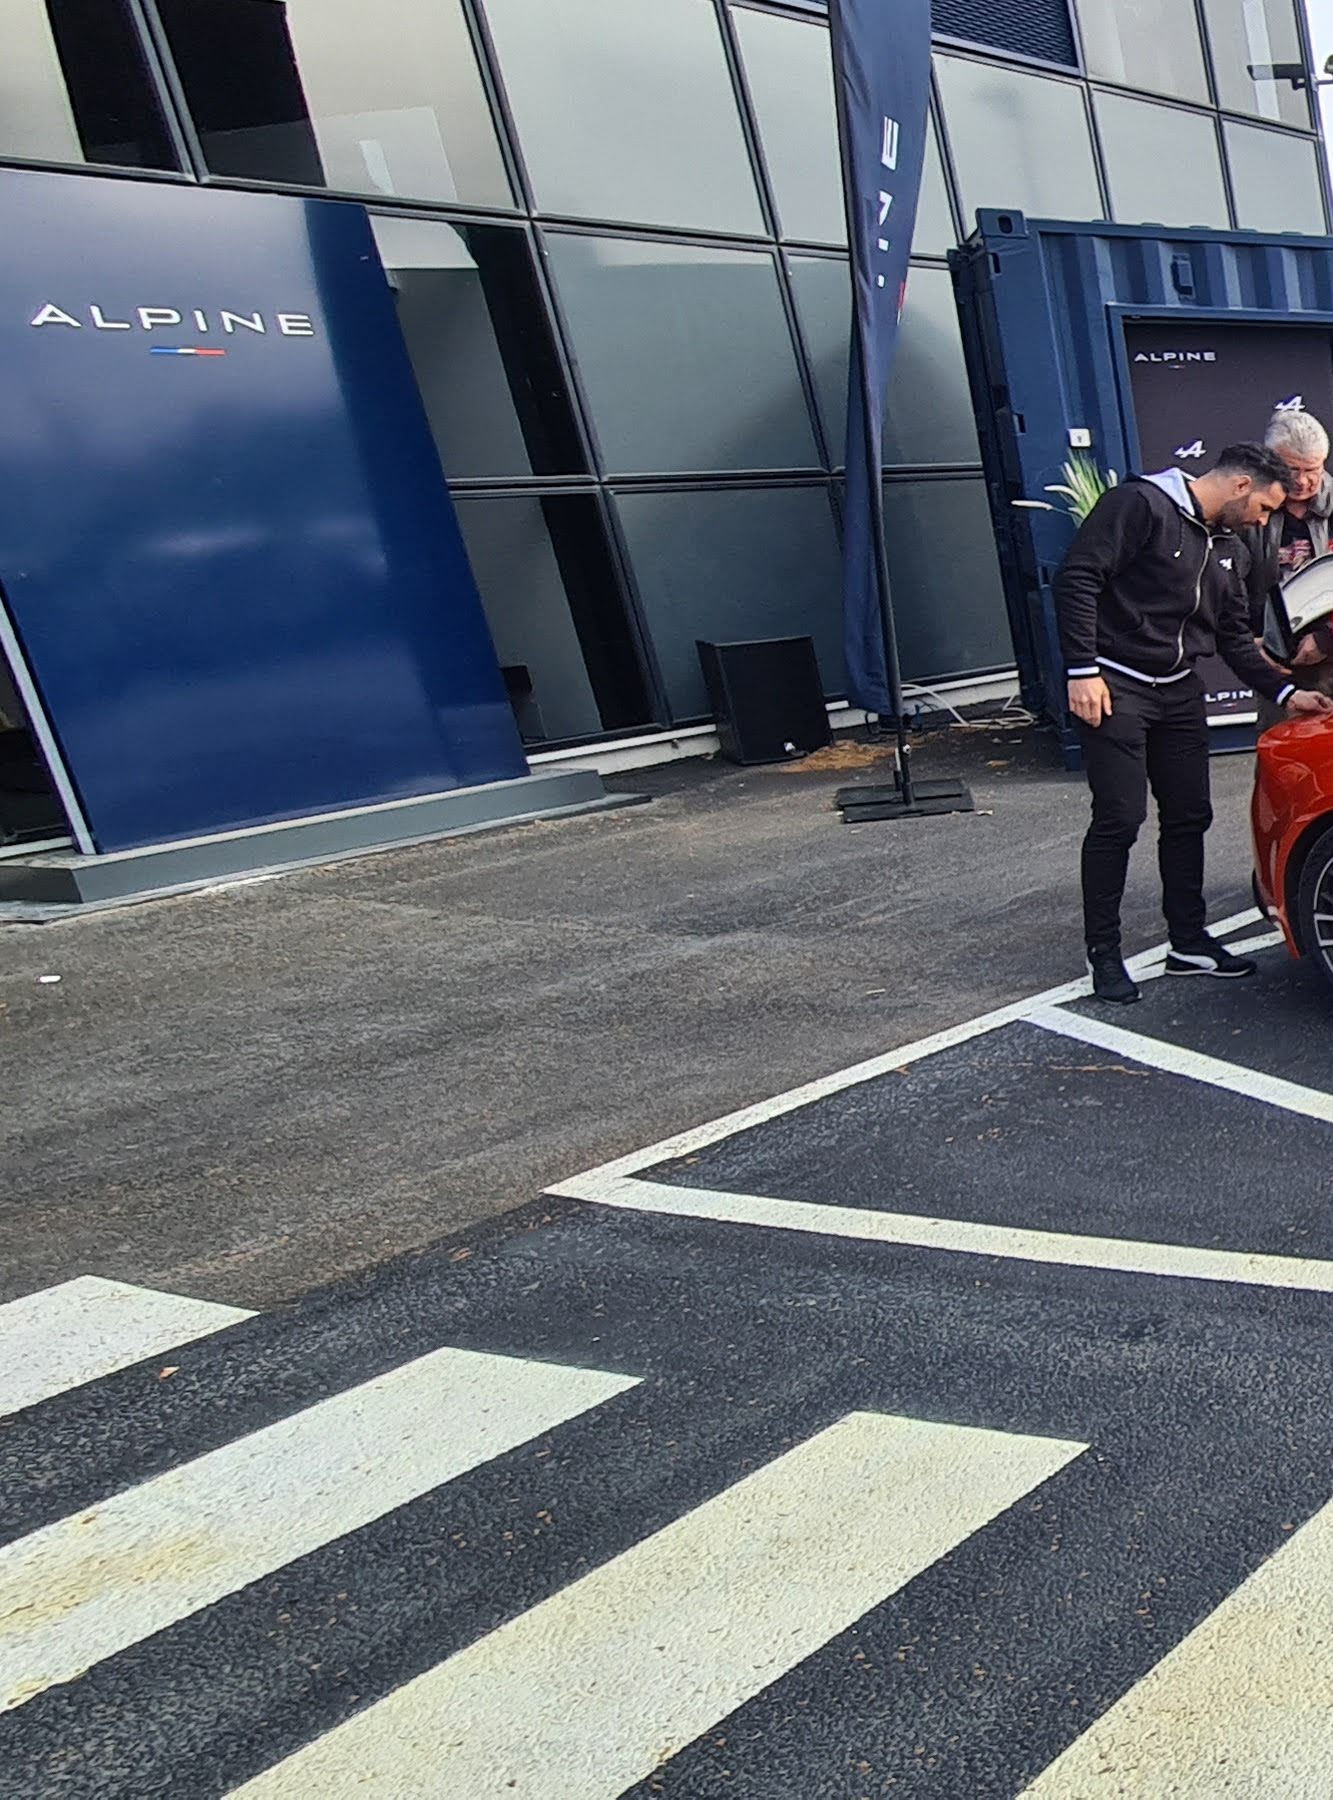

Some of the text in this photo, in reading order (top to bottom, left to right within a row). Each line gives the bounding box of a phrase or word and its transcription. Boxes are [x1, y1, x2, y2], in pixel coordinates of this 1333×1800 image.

[30, 303, 315, 335] ALPINE
[1134, 352, 1216, 362] ALPINE
[1204, 689, 1254, 702] LPIN
